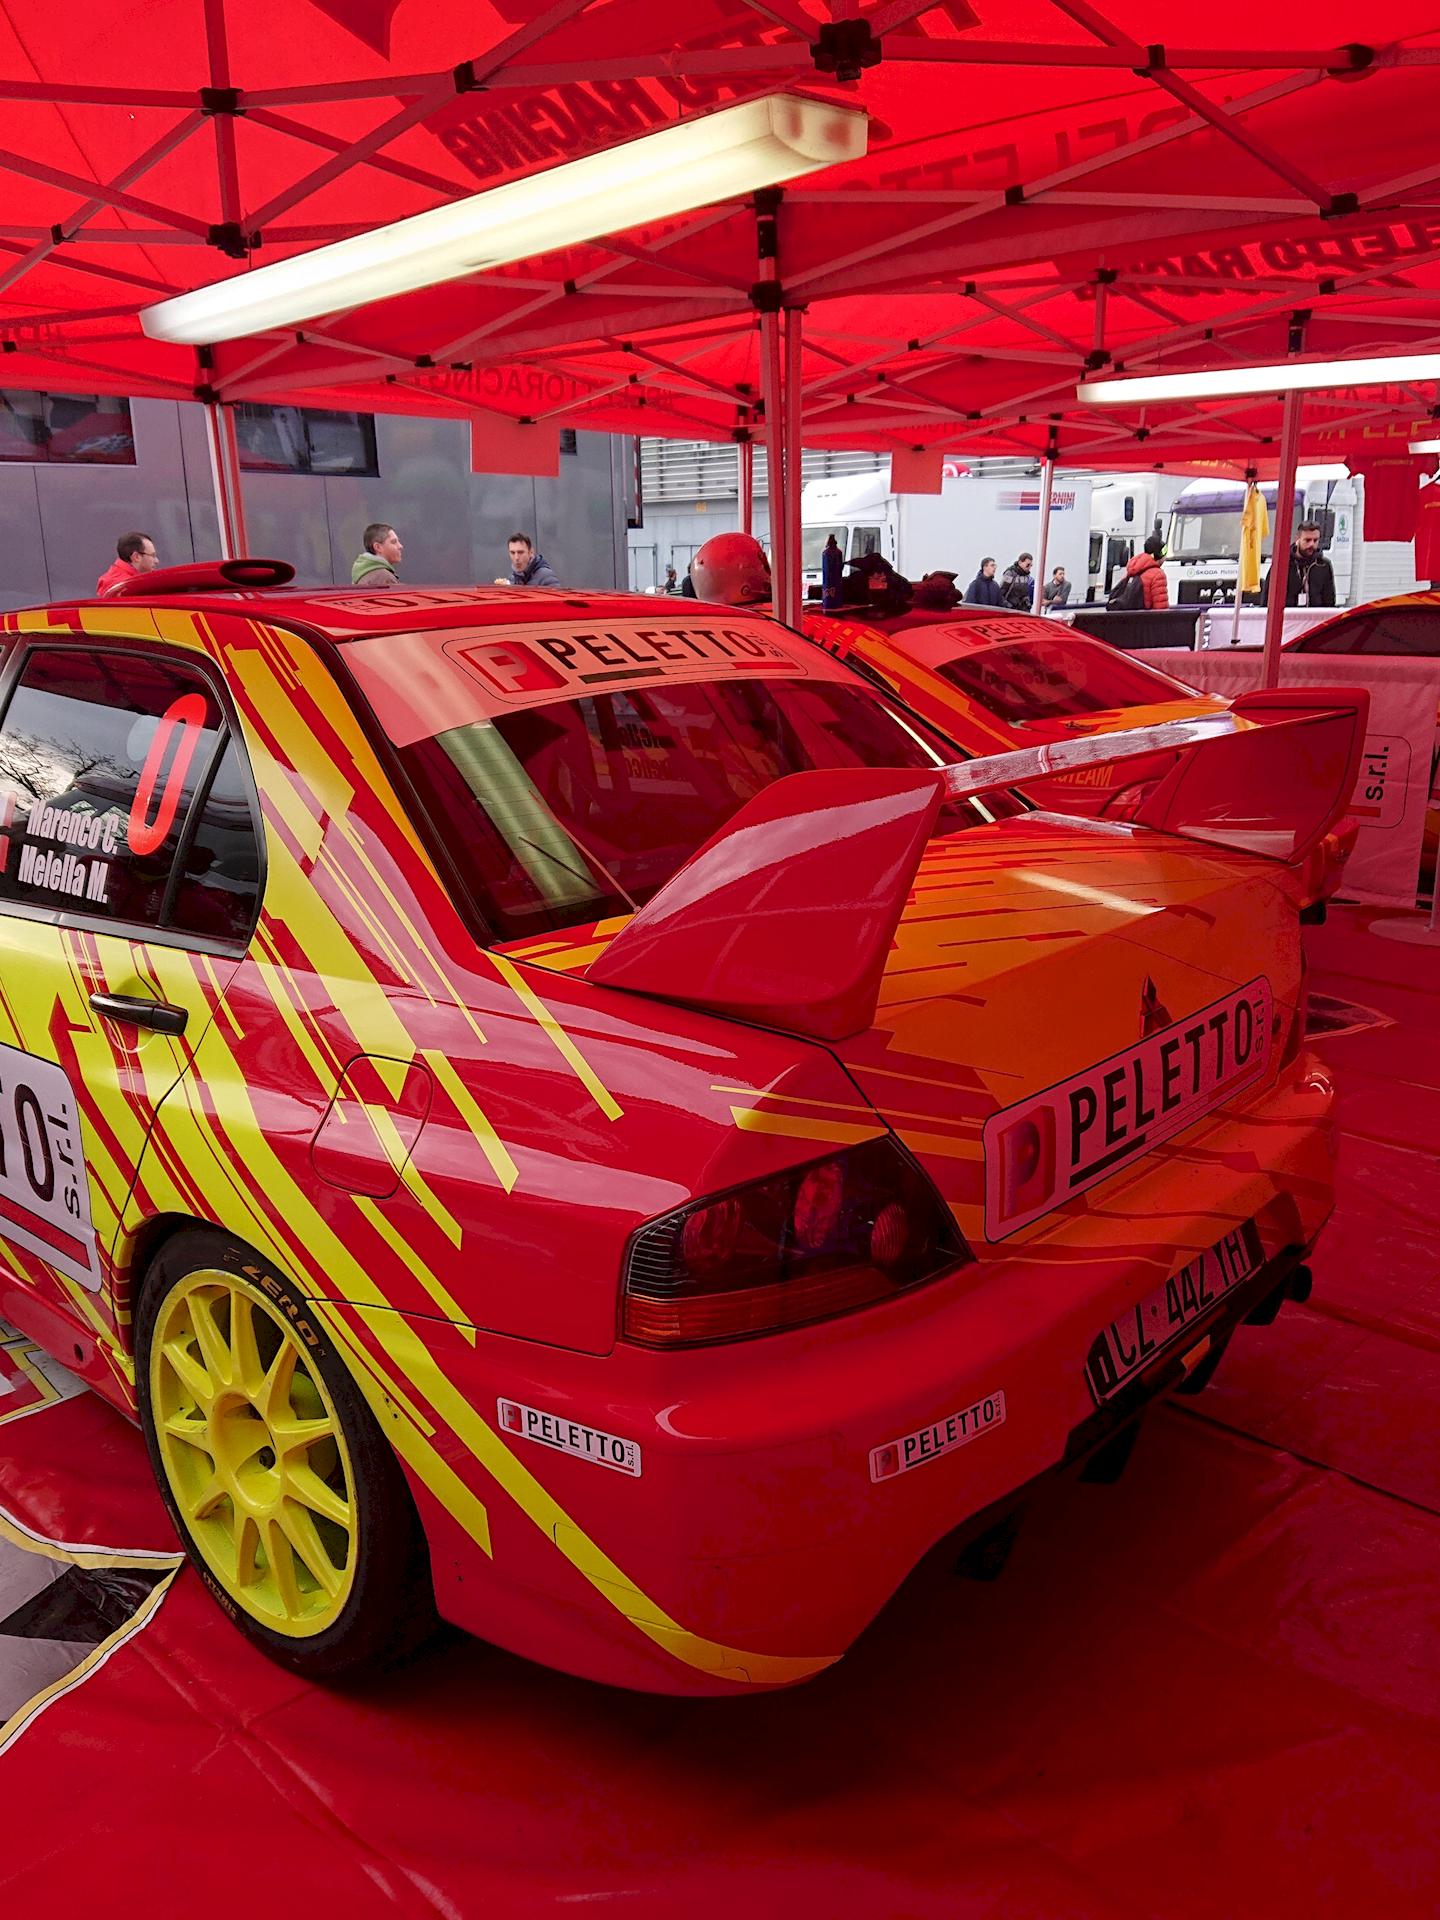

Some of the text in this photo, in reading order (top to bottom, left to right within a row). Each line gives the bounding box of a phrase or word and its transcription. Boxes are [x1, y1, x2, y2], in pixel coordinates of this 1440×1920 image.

[1200, 588, 1237, 597] MAN
[535, 629, 768, 670] PELETTO
[26, 798, 120, 855] Marenco C.
[18, 844, 109, 904] Melella M.
[1069, 999, 1253, 1167] PELETTO
[241, 1265, 319, 1346] ZERO
[527, 1410, 625, 1463] PELETTO
[903, 1399, 994, 1462] PELETTO
